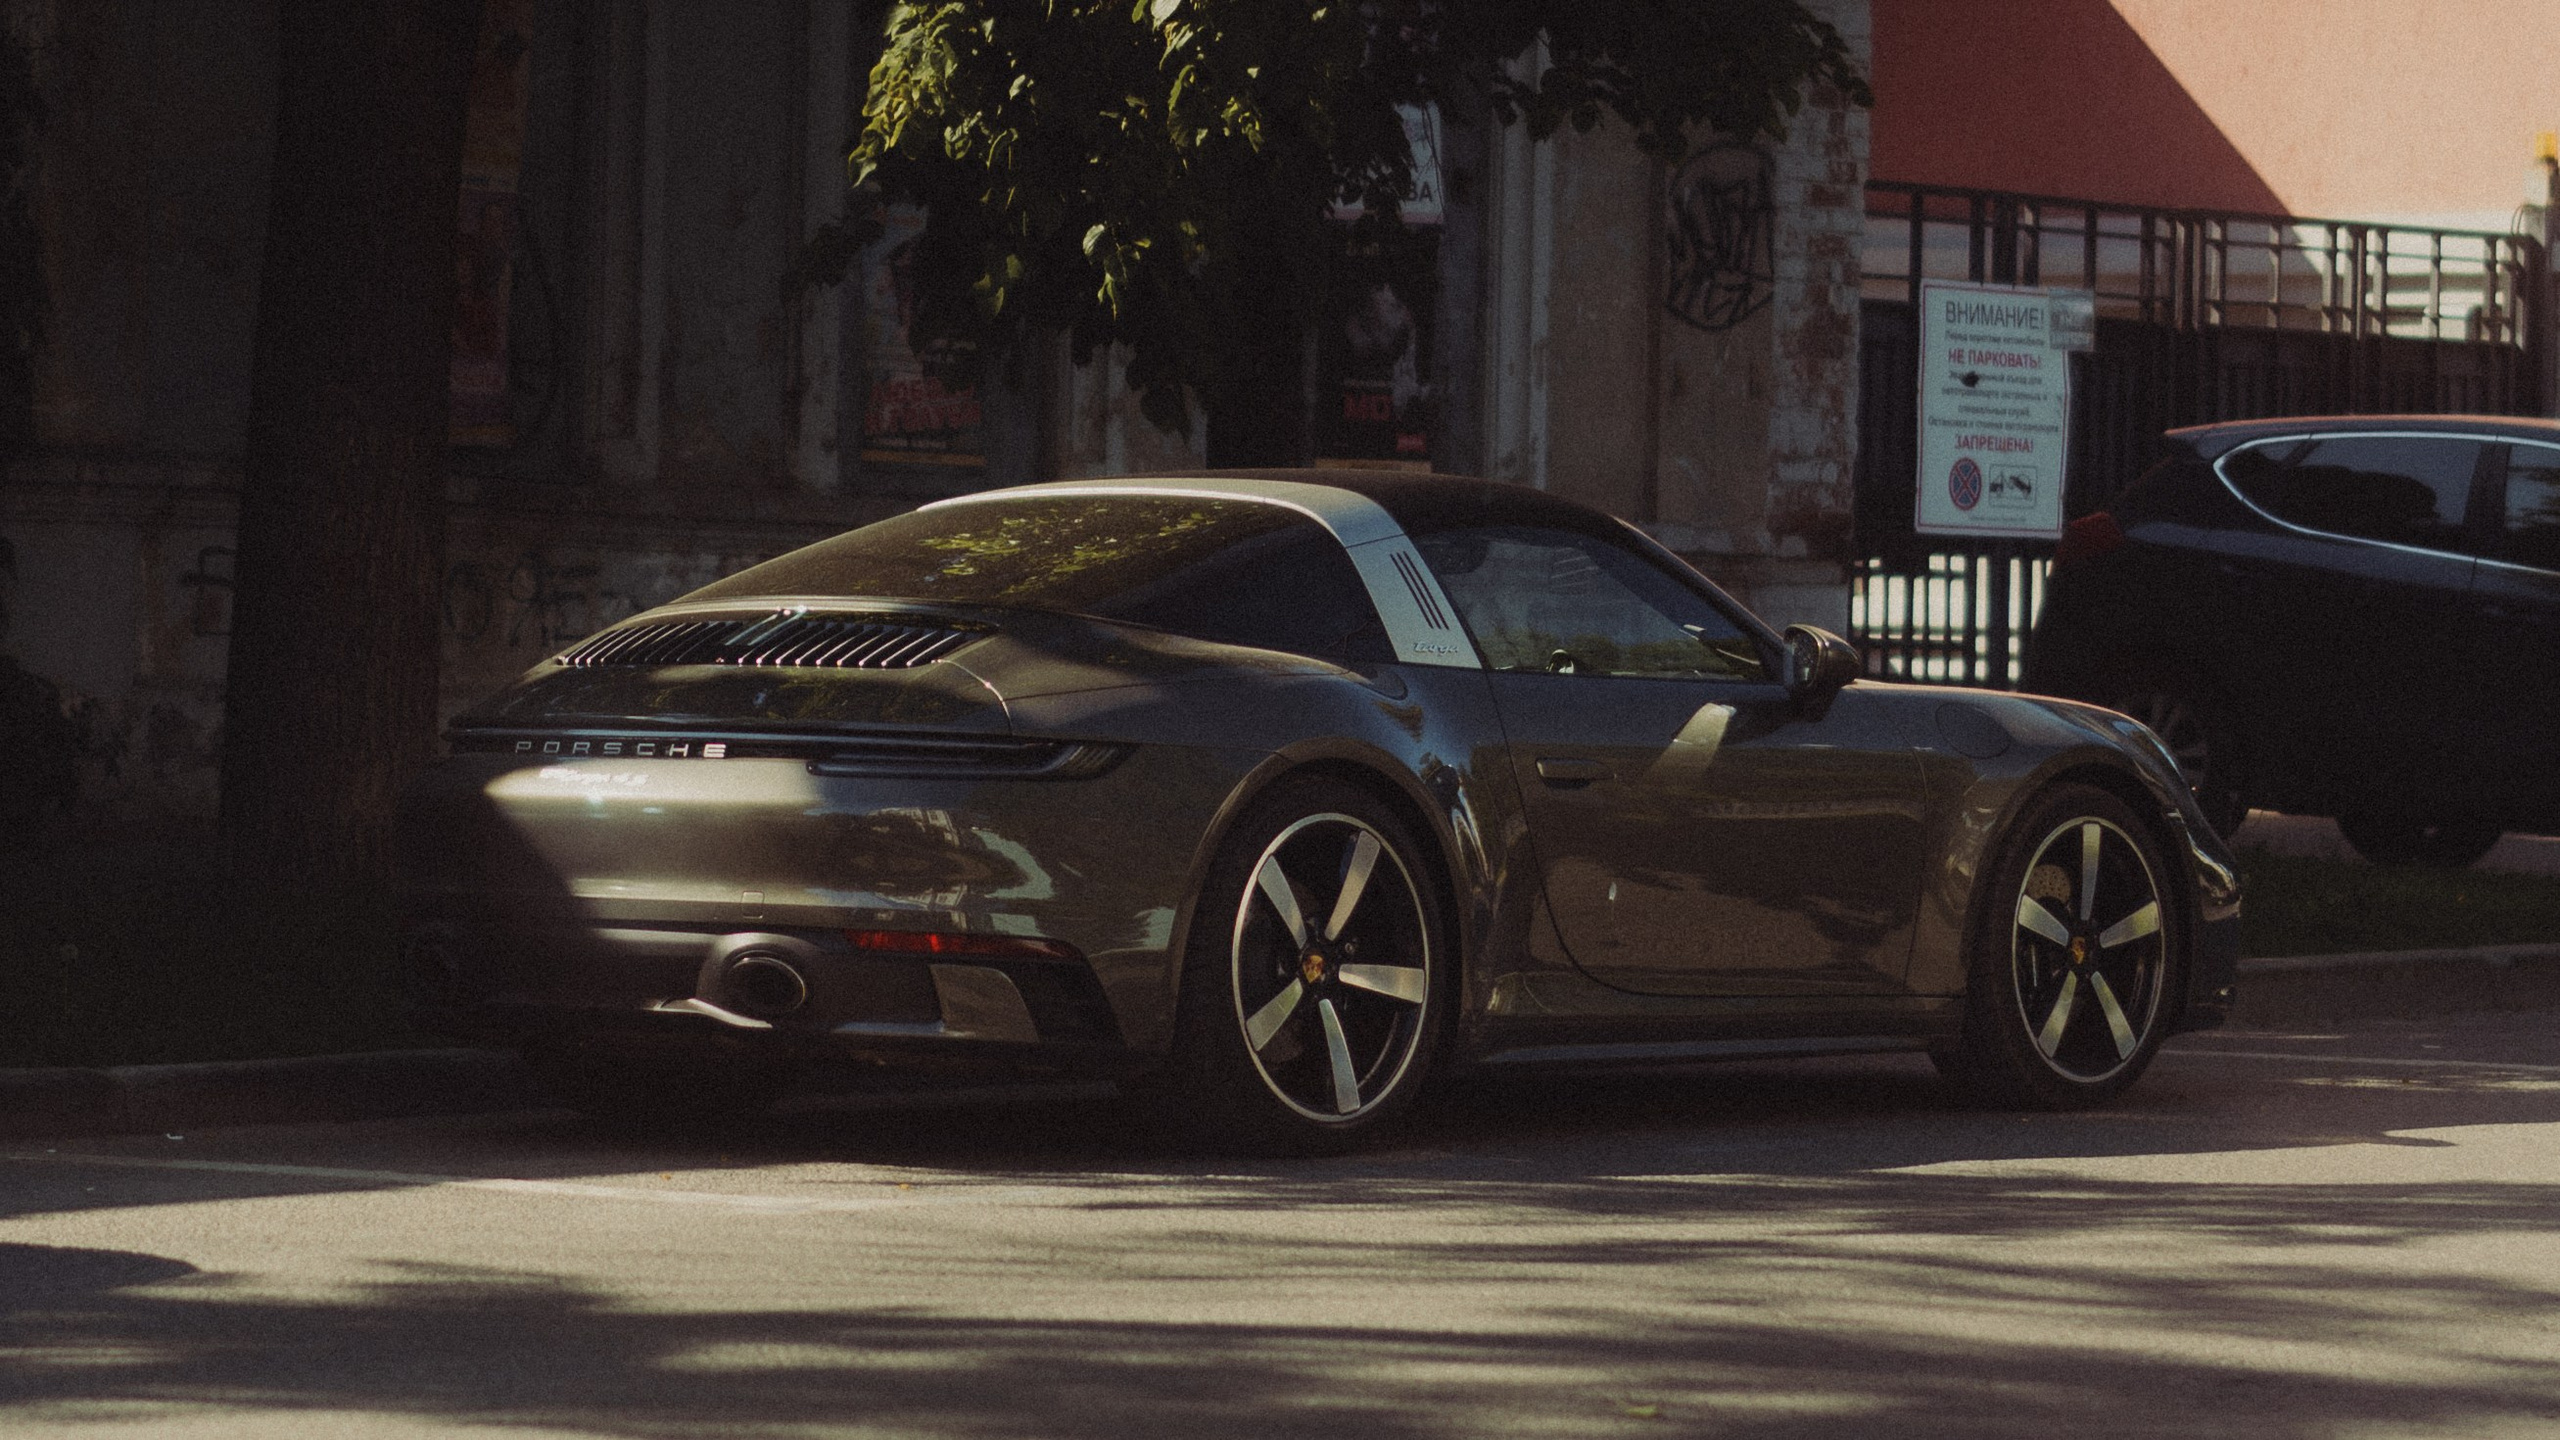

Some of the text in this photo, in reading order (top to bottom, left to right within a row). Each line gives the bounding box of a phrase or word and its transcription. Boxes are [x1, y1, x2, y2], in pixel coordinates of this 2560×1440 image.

[1945, 301, 2044, 330] ВНИМАНИЕ!
[1948, 348, 2041, 369] НЕ ПАРКОВАТЬ!
[1954, 434, 2034, 454] ЗАПРЕЩЕНА!
[515, 741, 727, 758] PORSCHE
